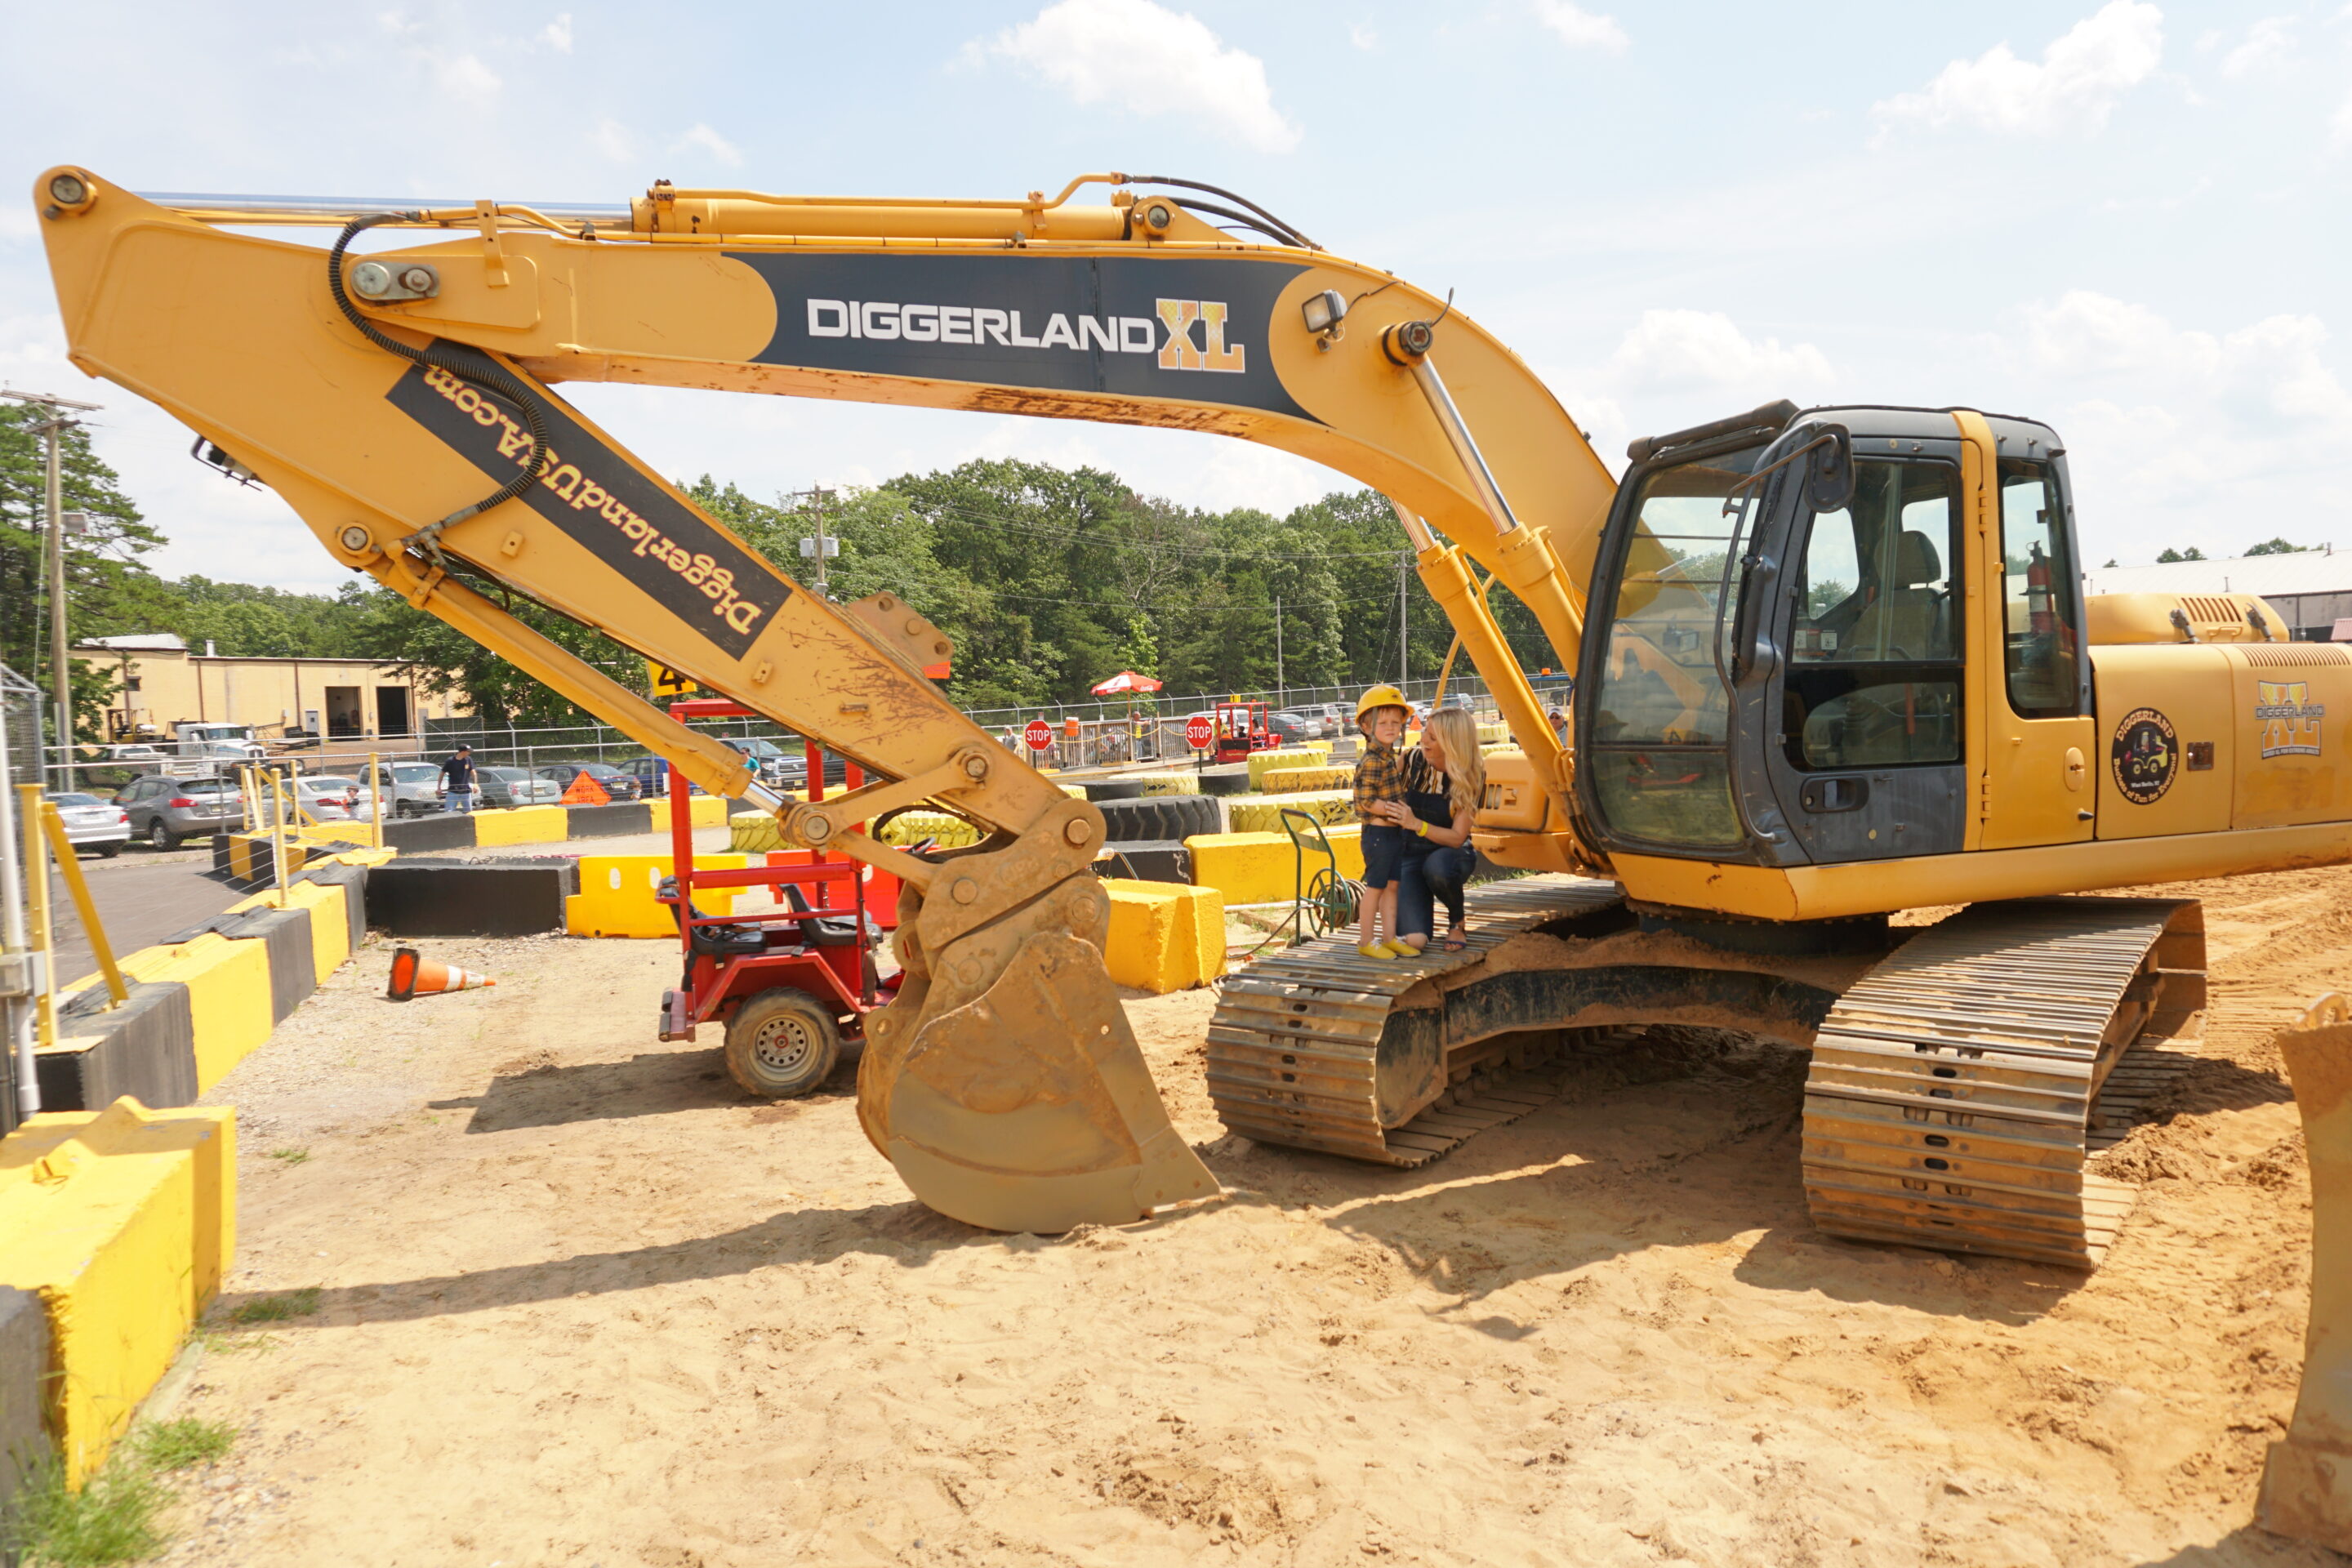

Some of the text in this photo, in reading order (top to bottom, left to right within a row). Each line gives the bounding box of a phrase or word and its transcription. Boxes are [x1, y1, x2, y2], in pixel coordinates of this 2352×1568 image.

[807, 297, 1245, 373] DIGGERLAND XL
[658, 668, 685, 692] 4
[2256, 706, 2323, 719] DIGGERLAND
[1027, 729, 1050, 742] STOP
[1187, 726, 1211, 738] STOP
[2116, 710, 2174, 742] DIGGERLAND
[2114, 758, 2127, 792] Buckets
[2134, 794, 2148, 803] Fun
[2149, 792, 2158, 801] for
